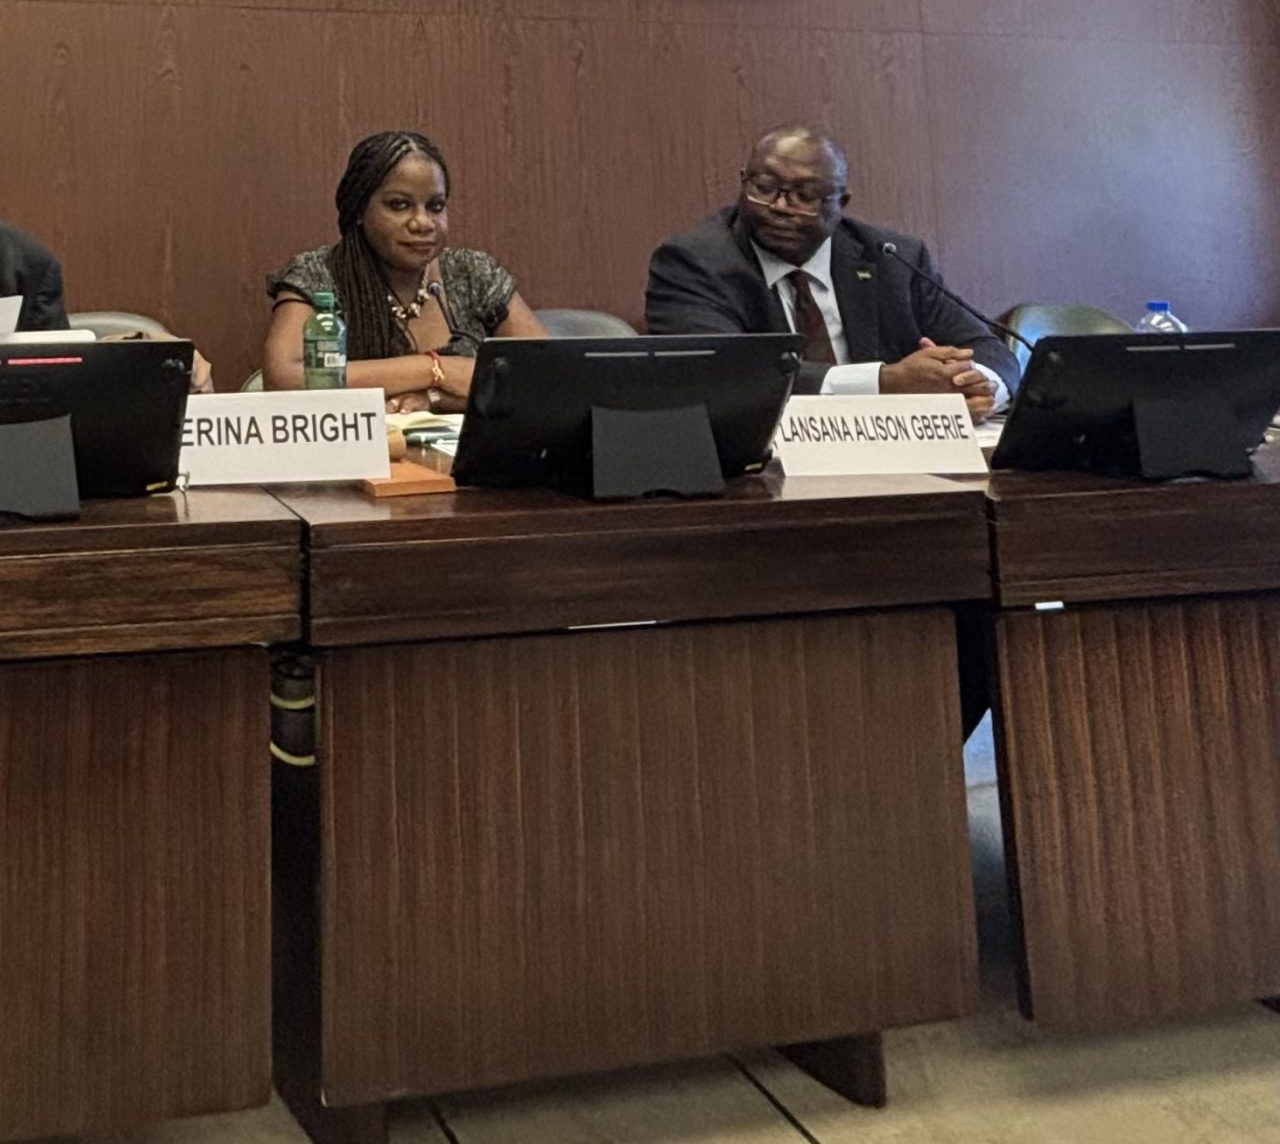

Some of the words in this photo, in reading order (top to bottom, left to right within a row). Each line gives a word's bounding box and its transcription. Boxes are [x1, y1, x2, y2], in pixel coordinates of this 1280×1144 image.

[271, 412, 377, 444] BRIGHT
[780, 415, 854, 442] LANSANA
[855, 414, 911, 441] ALISON
[911, 414, 969, 439] GBERIE
